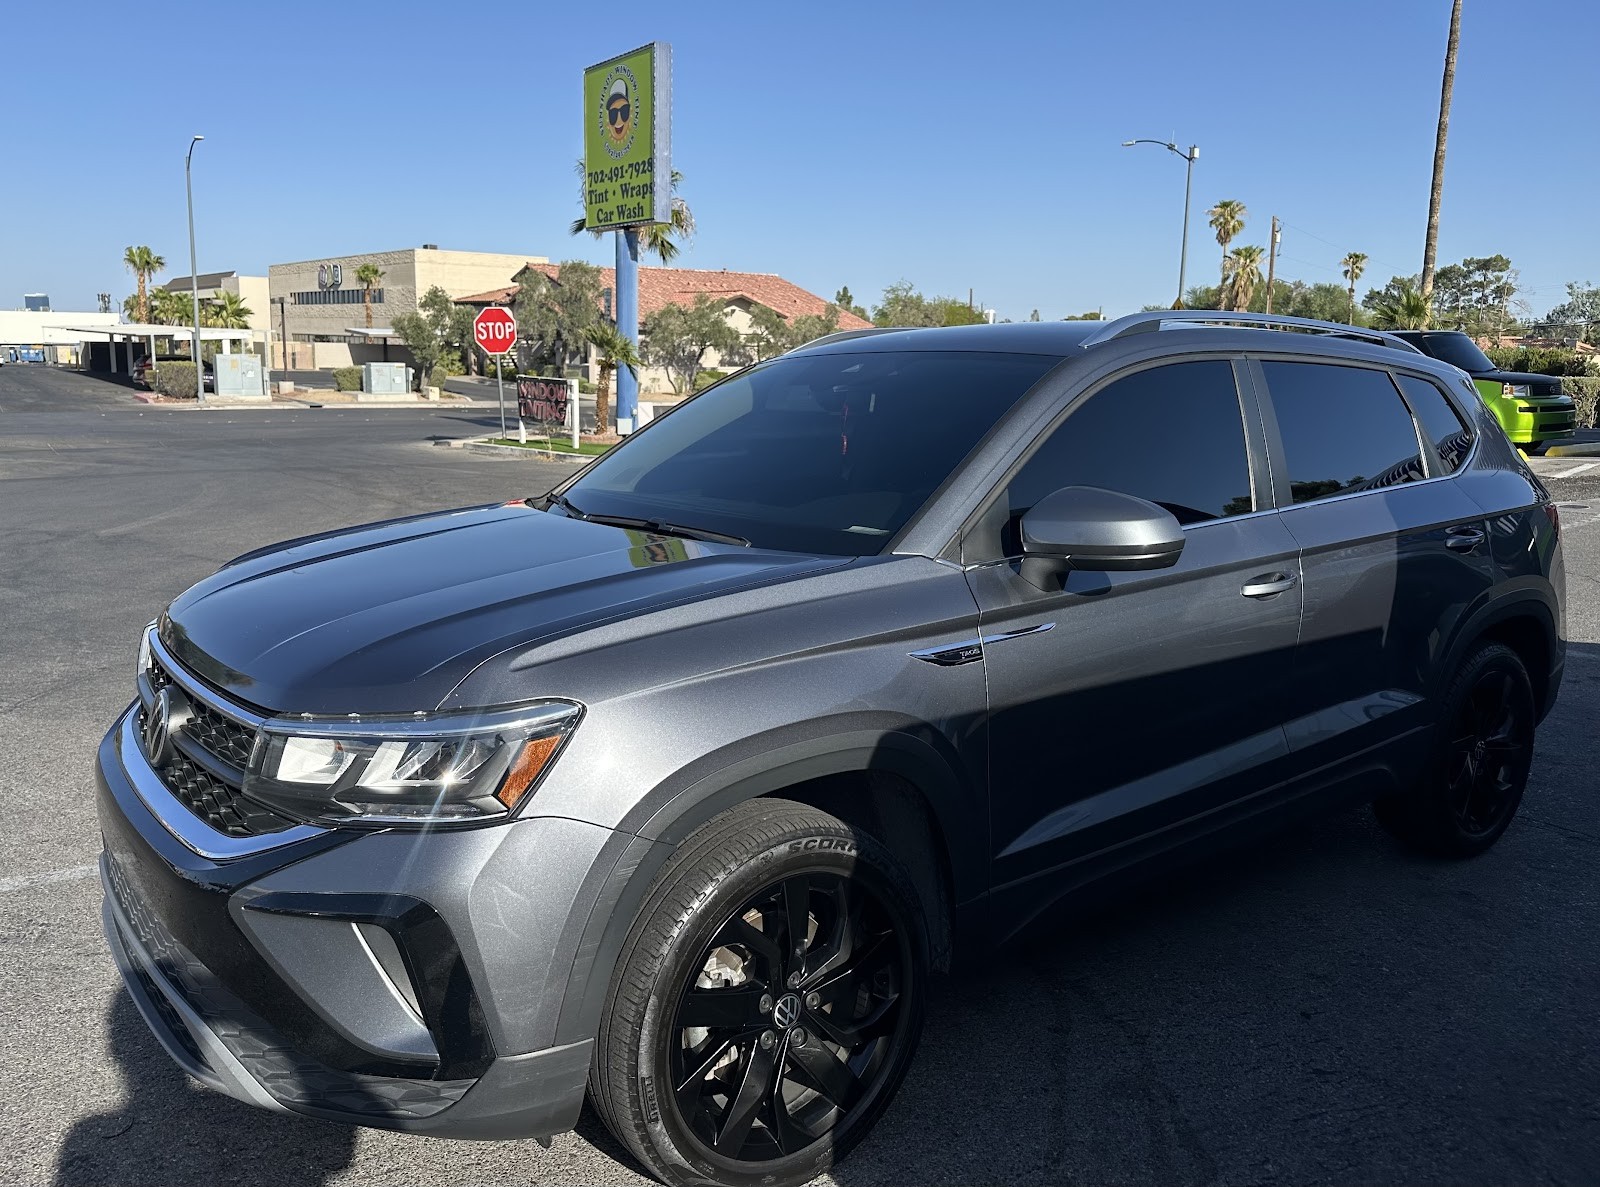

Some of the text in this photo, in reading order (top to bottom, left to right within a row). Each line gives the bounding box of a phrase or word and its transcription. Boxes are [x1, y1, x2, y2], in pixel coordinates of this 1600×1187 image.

[614, 65, 638, 91] WINDOW
[588, 182, 653, 206] Tint Wraps
[596, 202, 644, 224] Car Wash
[477, 321, 514, 341] STOP
[518, 380, 567, 402] WINDOW
[519, 398, 566, 422] TINTING
